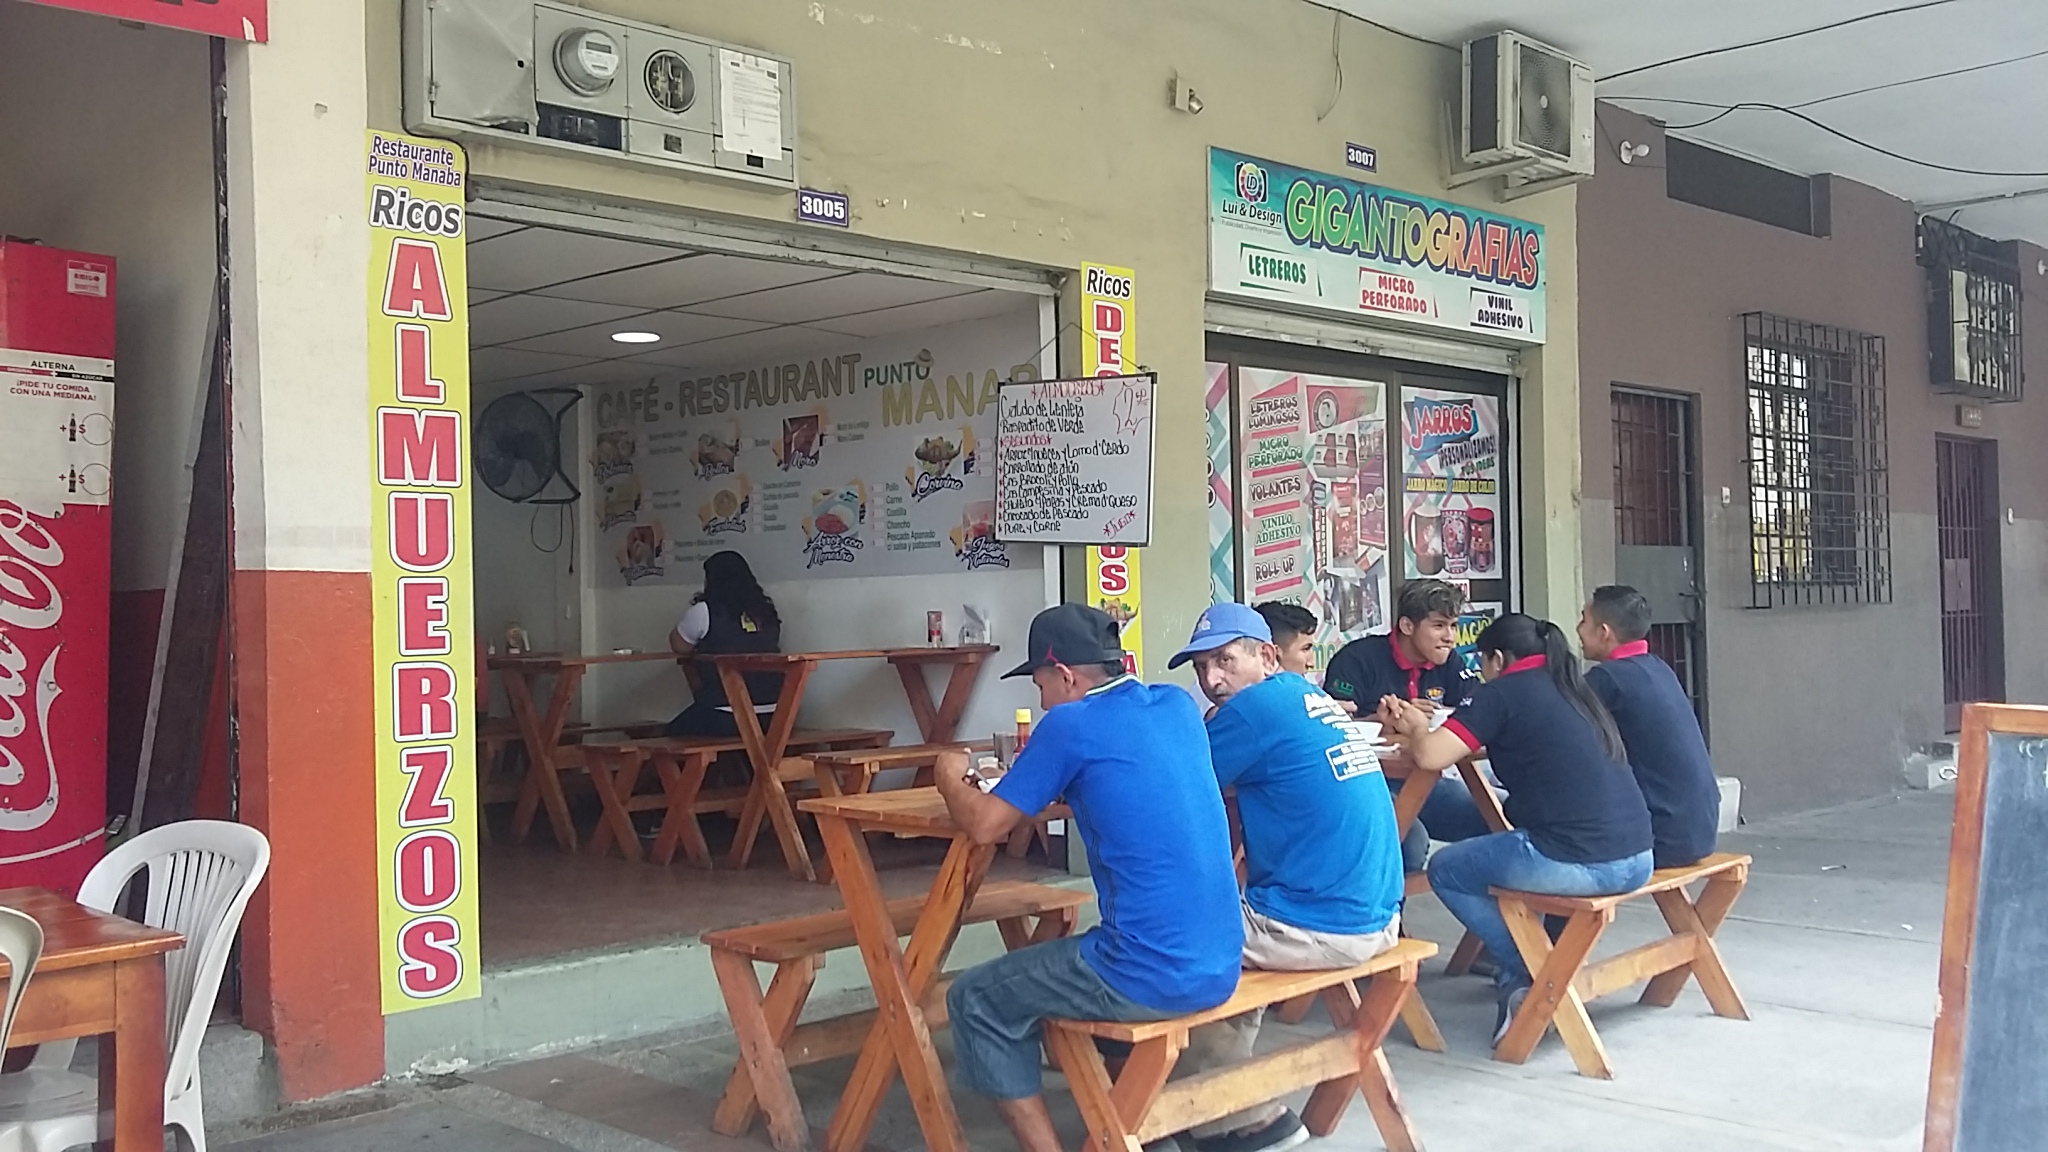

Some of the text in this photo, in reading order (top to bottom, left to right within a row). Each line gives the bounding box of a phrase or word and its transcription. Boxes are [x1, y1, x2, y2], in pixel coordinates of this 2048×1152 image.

[372, 135, 454, 166] Restaurante
[1348, 148, 1374, 167] 3007
[368, 154, 461, 187] Punto Manaba
[371, 187, 461, 235] Ricos
[801, 198, 845, 220] 3005
[1222, 199, 1282, 226] Lui & Design
[1287, 180, 1538, 287] GIGANTOGRAFIAS
[1248, 254, 1307, 285] LETREROS
[1087, 268, 1131, 298] Ricos
[1378, 275, 1415, 295] MICRO
[1361, 289, 1427, 314] PERFORADO
[1487, 294, 1514, 312] VINIL
[1477, 308, 1524, 330] ADHESIVO
[30, 360, 76, 371] ALTERNA
[10, 387, 30, 396] CON
[32, 388, 51, 397] UNA
[42, 382, 54, 390] TU
[56, 383, 90, 393] COMIDA
[597, 376, 660, 429] CAFÉ
[679, 353, 862, 420] RESTAURANT
[863, 360, 932, 390] PUNTO
[1250, 396, 1298, 415] LETREROS
[1248, 410, 1300, 430] LUMINOSOS
[1410, 404, 1473, 450] JARROS
[1259, 436, 1289, 452] MICRO
[1248, 446, 1303, 469] PERFORADO
[916, 471, 964, 497] Corvina
[1250, 477, 1301, 501] VOLANTES
[1261, 513, 1293, 531] VINILO
[1255, 524, 1301, 545] ADHESIVO
[1255, 557, 1295, 581] ROLL UP
[380, 240, 461, 995] ALMUERZOS
